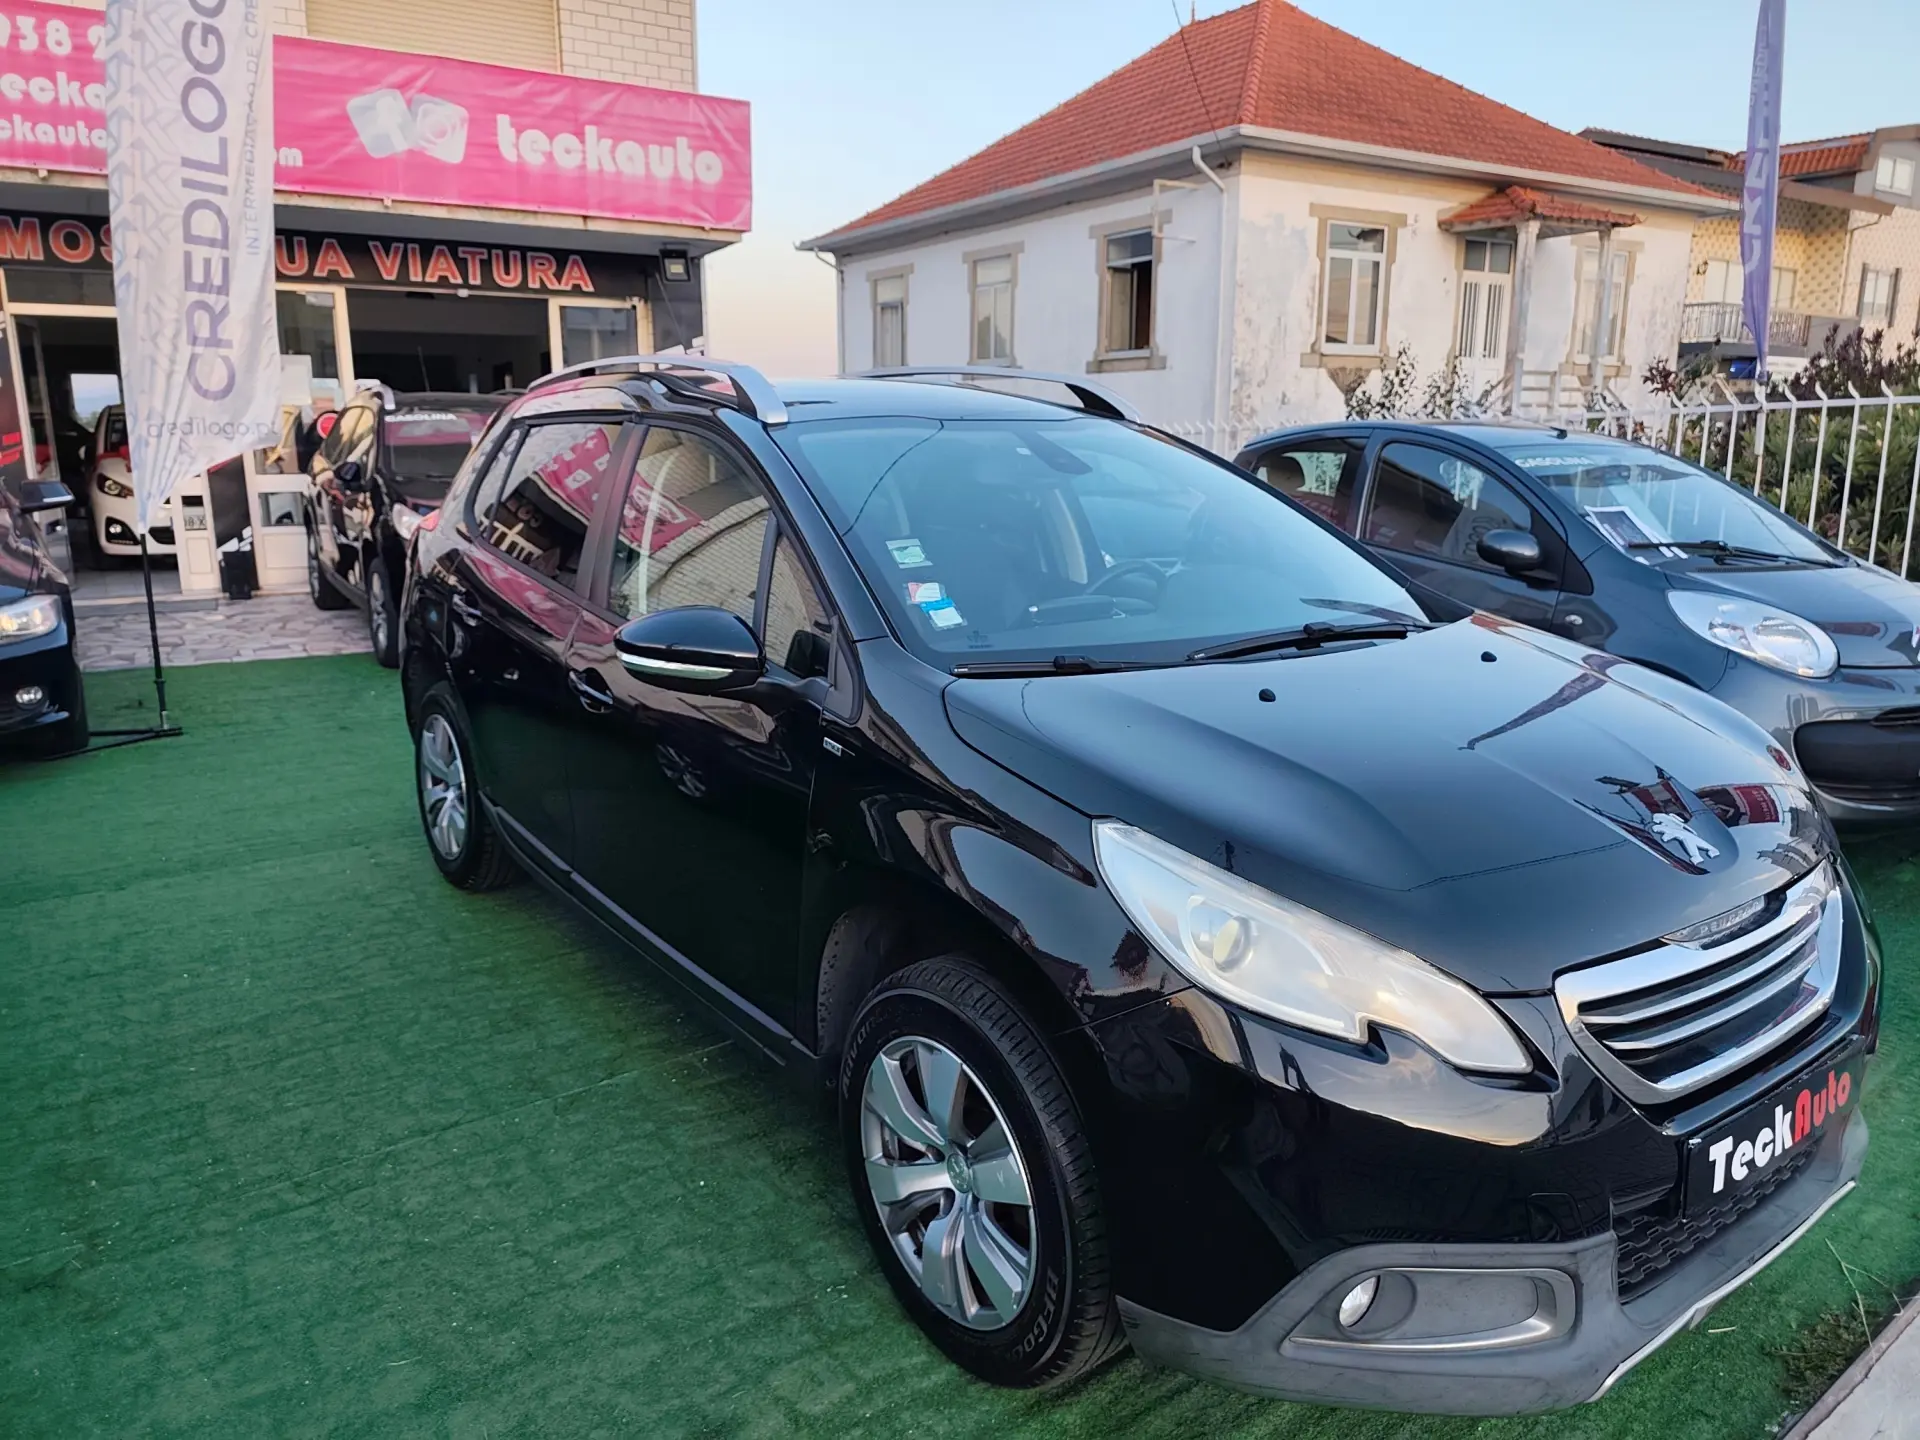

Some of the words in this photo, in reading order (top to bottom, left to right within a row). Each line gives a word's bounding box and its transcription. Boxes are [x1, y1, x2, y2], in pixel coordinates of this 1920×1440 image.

[496, 113, 724, 186] teckauto
[368, 241, 595, 293] VIATURA
[1708, 1069, 1851, 1194] TeckAuto
